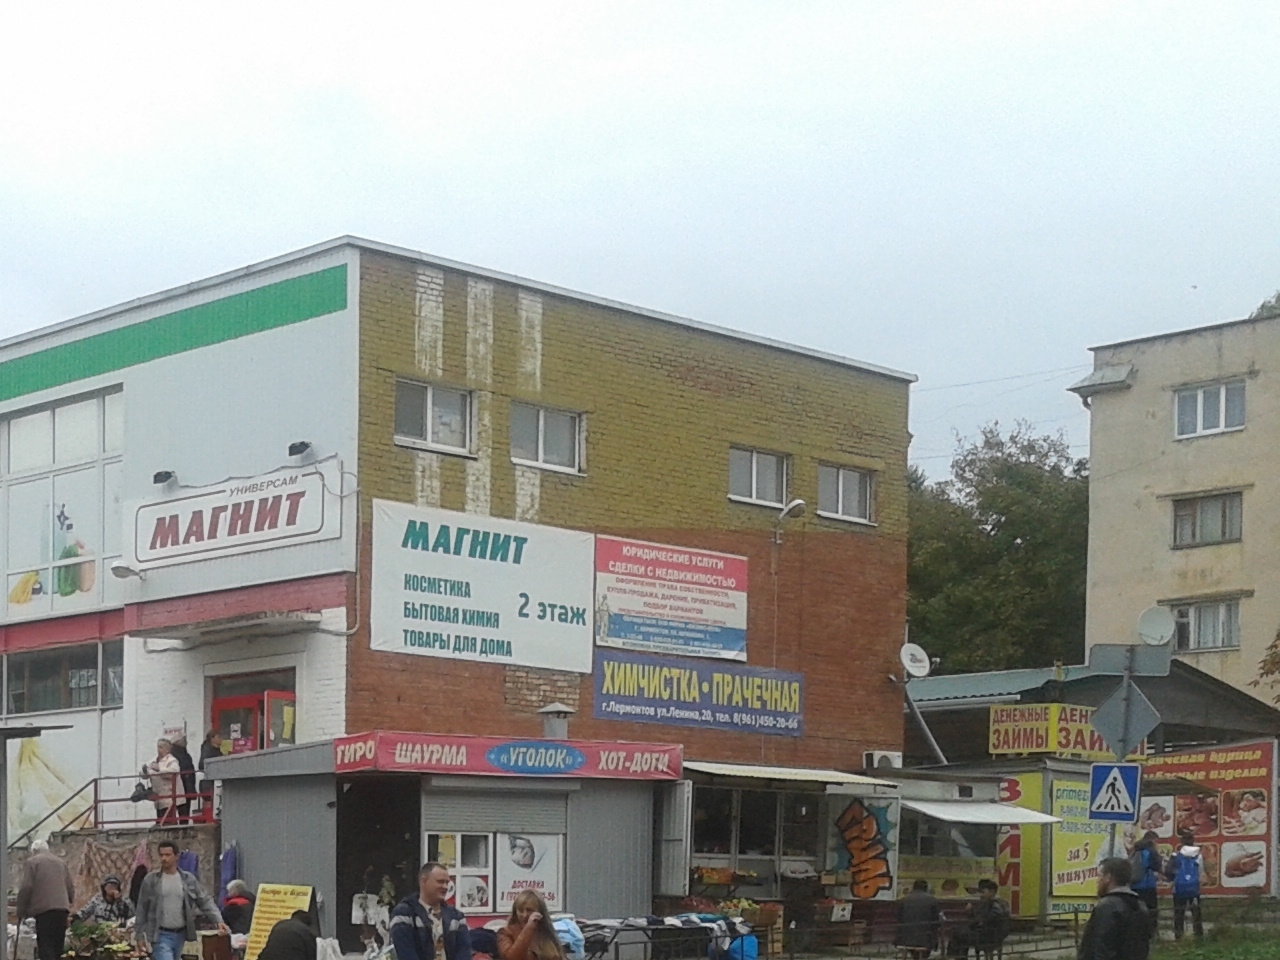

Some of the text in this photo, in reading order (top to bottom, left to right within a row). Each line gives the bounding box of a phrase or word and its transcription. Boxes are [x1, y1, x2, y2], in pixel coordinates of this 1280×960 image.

[228, 476, 298, 497] УНИВЕРСАМ
[149, 490, 306, 550] МАГНИТ
[401, 519, 528, 564] МАГНИТ
[622, 545, 724, 570] ЮРИДИЧЕСКИЕ УСЛУГИ
[404, 573, 471, 598] КОСМЕТИКА
[608, 561, 736, 588] СДЕЛКИ С НЕДВИЖИМОСТЬЮ
[403, 601, 500, 629] БЫТОВАЯ ХИМИЯ
[518, 592, 587, 626] 2 этаж
[403, 629, 512, 657] ТОВАРЫ ДЛЯ ДОМА
[602, 660, 800, 713] ХИМЧИСТКА ПРАЧЕЧНАЯ
[992, 706, 1049, 725] ДЕНЕЖНЫЕ
[992, 724, 1049, 750] ЗАЙМЫ
[395, 742, 467, 766] ШАУРМА
[598, 750, 669, 774] ХОТ-ДОГИ
[1067, 849, 1080, 862] за
[511, 879, 545, 890] ДОСТАВКА
